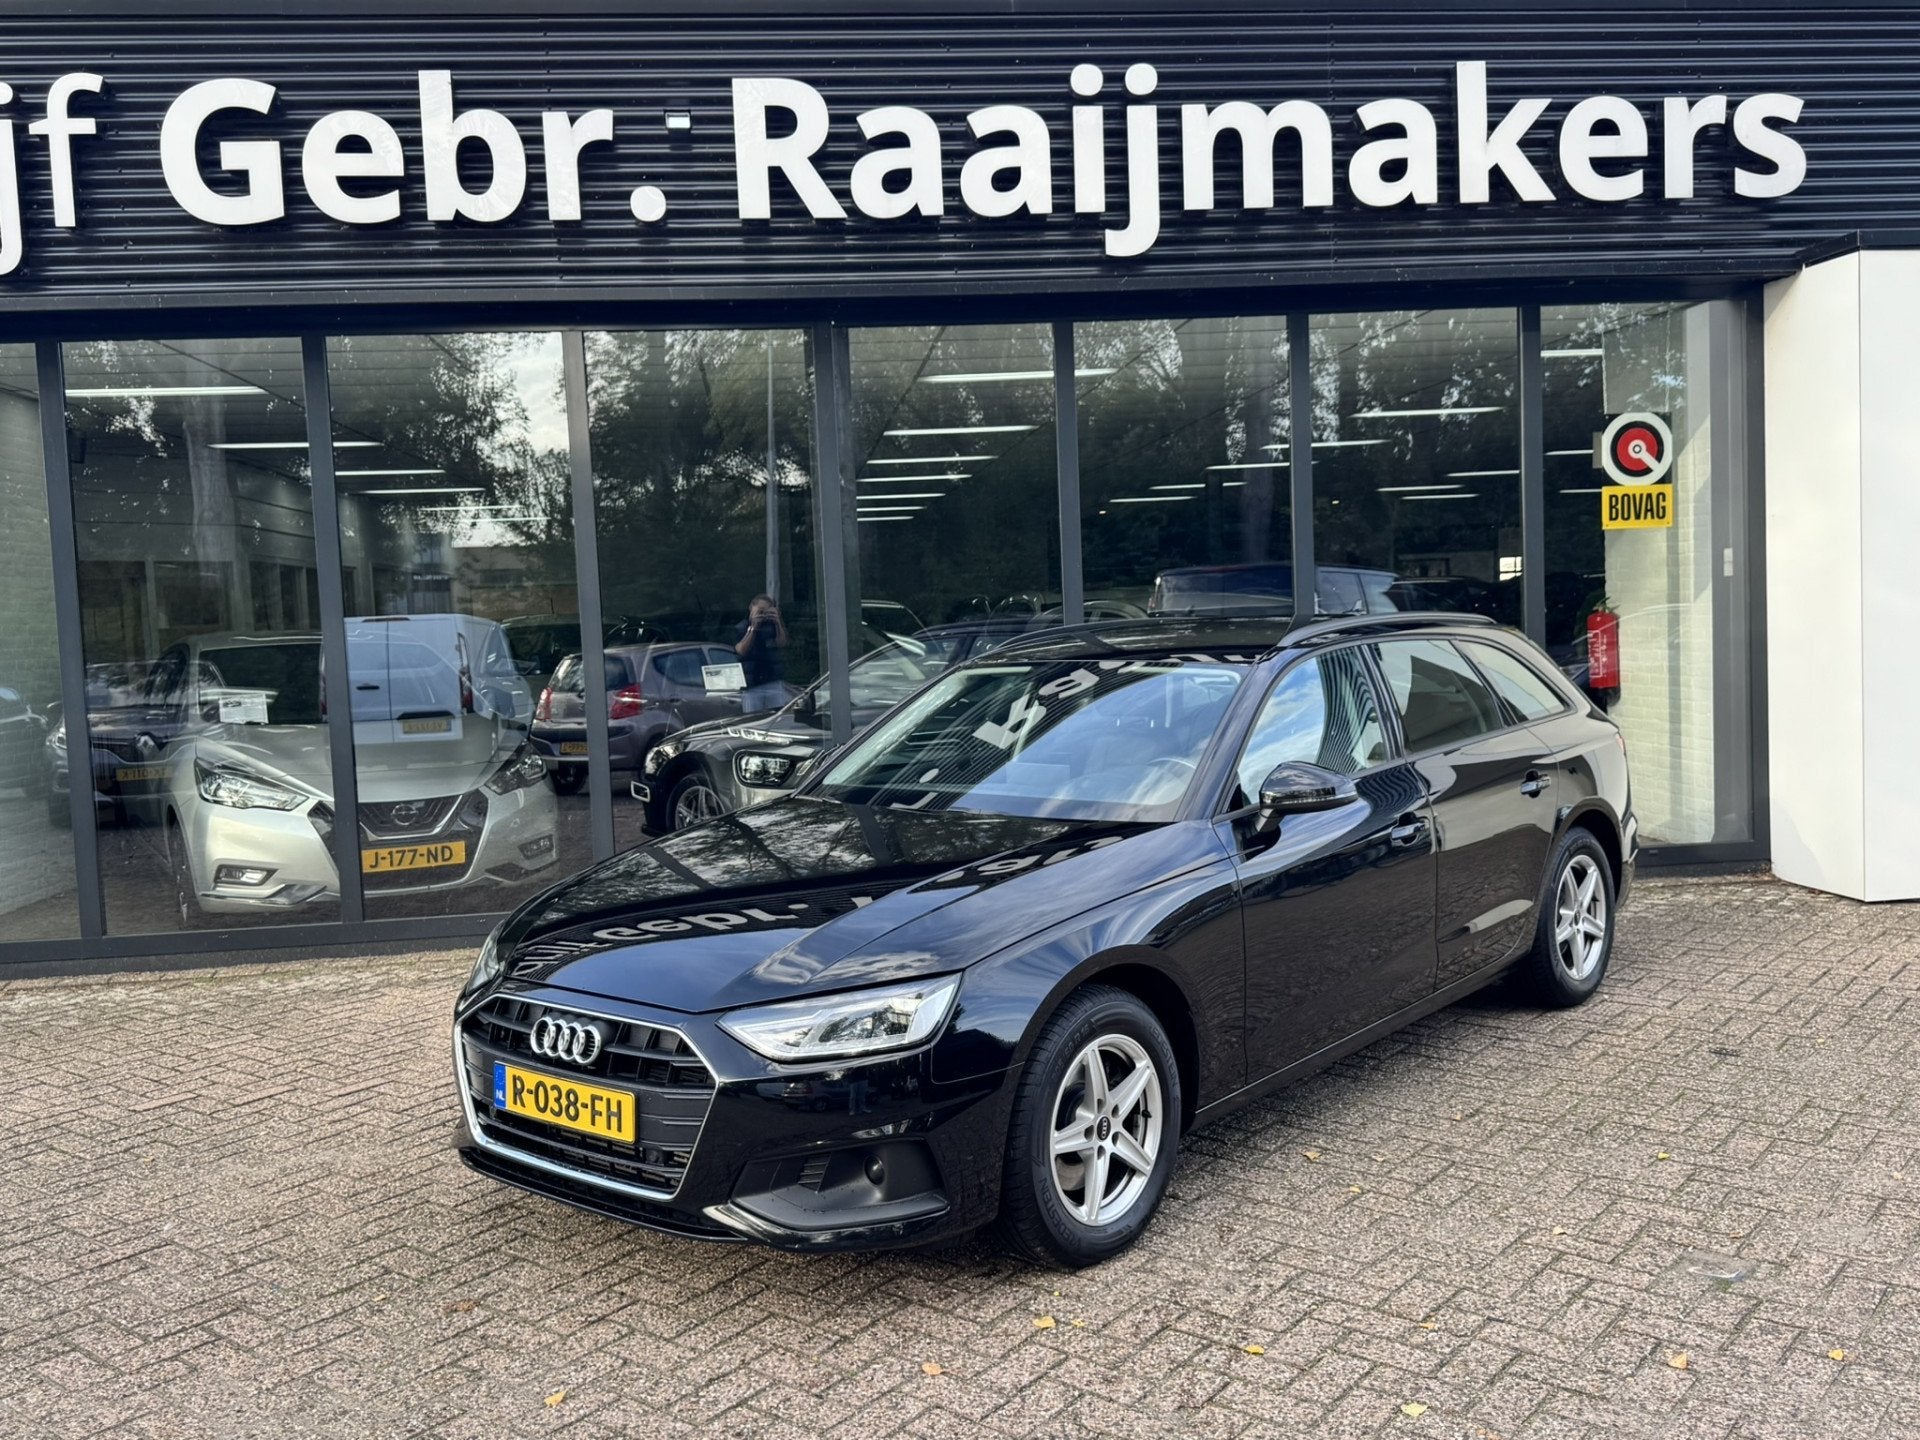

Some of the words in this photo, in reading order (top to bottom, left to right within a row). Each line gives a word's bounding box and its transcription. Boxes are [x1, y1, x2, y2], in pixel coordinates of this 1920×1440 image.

[160, 69, 667, 225] Gebr.
[732, 60, 1808, 257] Raaijmakers
[1608, 491, 1667, 522] BOVAG
[369, 845, 453, 869] J-177-ND
[495, 1089, 506, 1101] NL
[512, 1074, 622, 1133] R-038-FH
